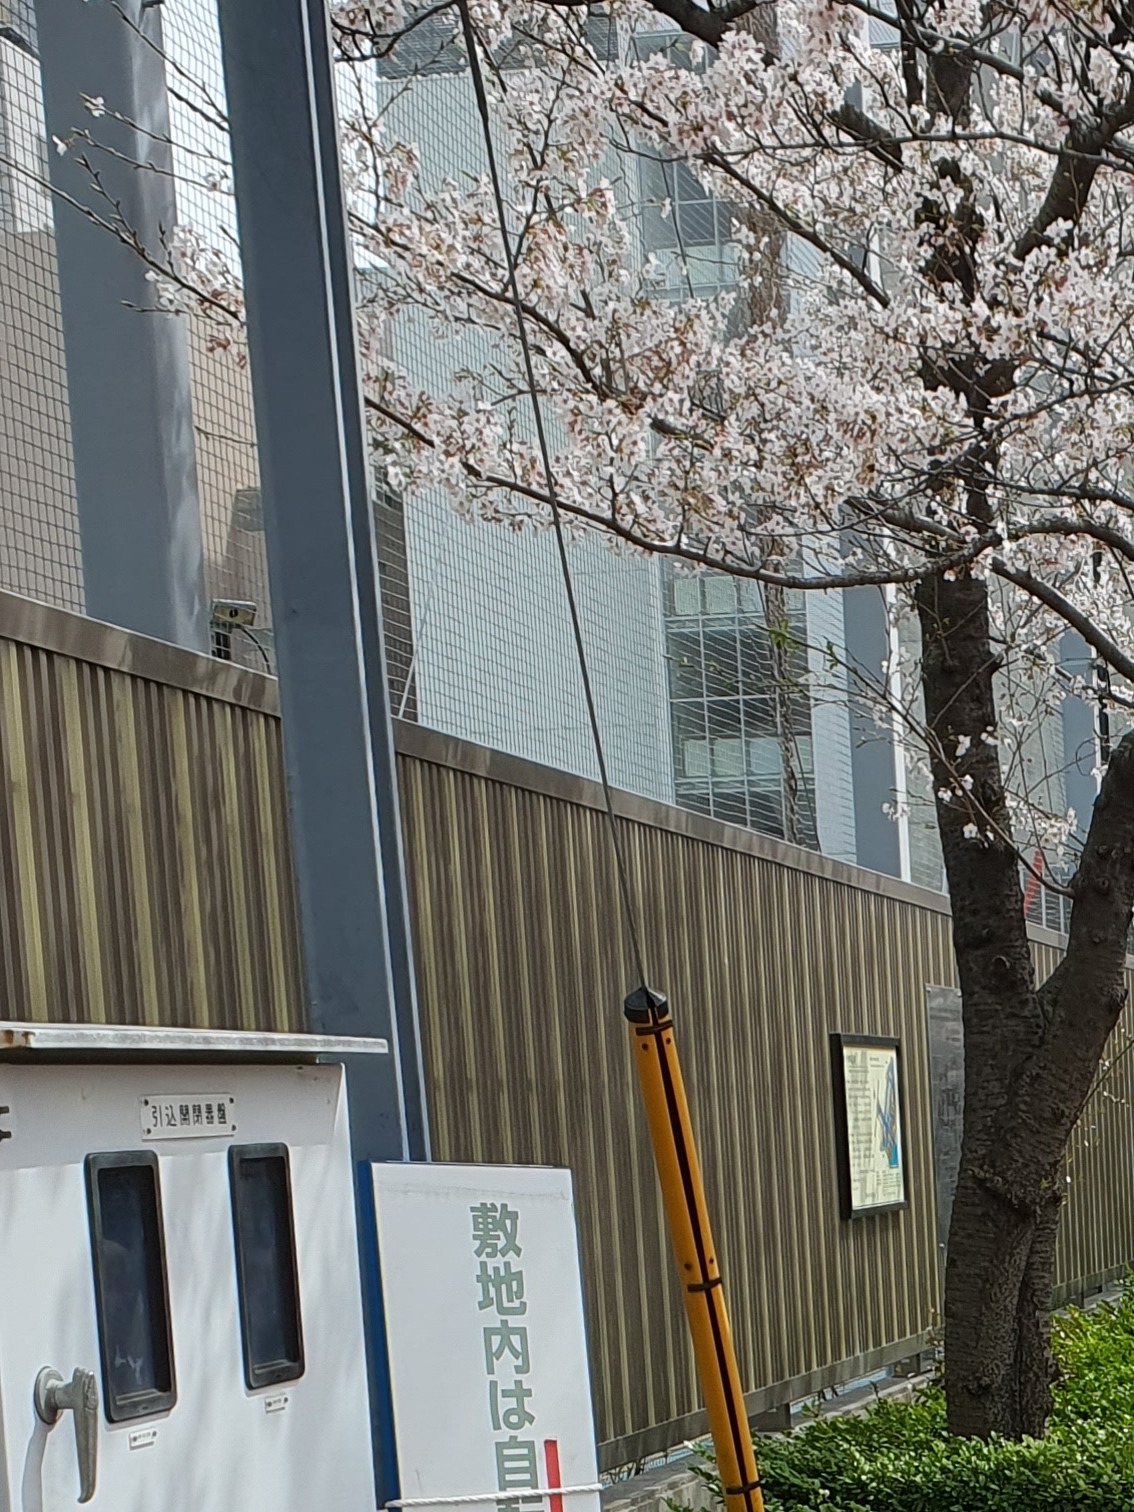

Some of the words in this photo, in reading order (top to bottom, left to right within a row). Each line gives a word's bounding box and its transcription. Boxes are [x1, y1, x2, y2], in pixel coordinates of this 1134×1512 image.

[151, 1103, 227, 1128] 引込開閉器盤
